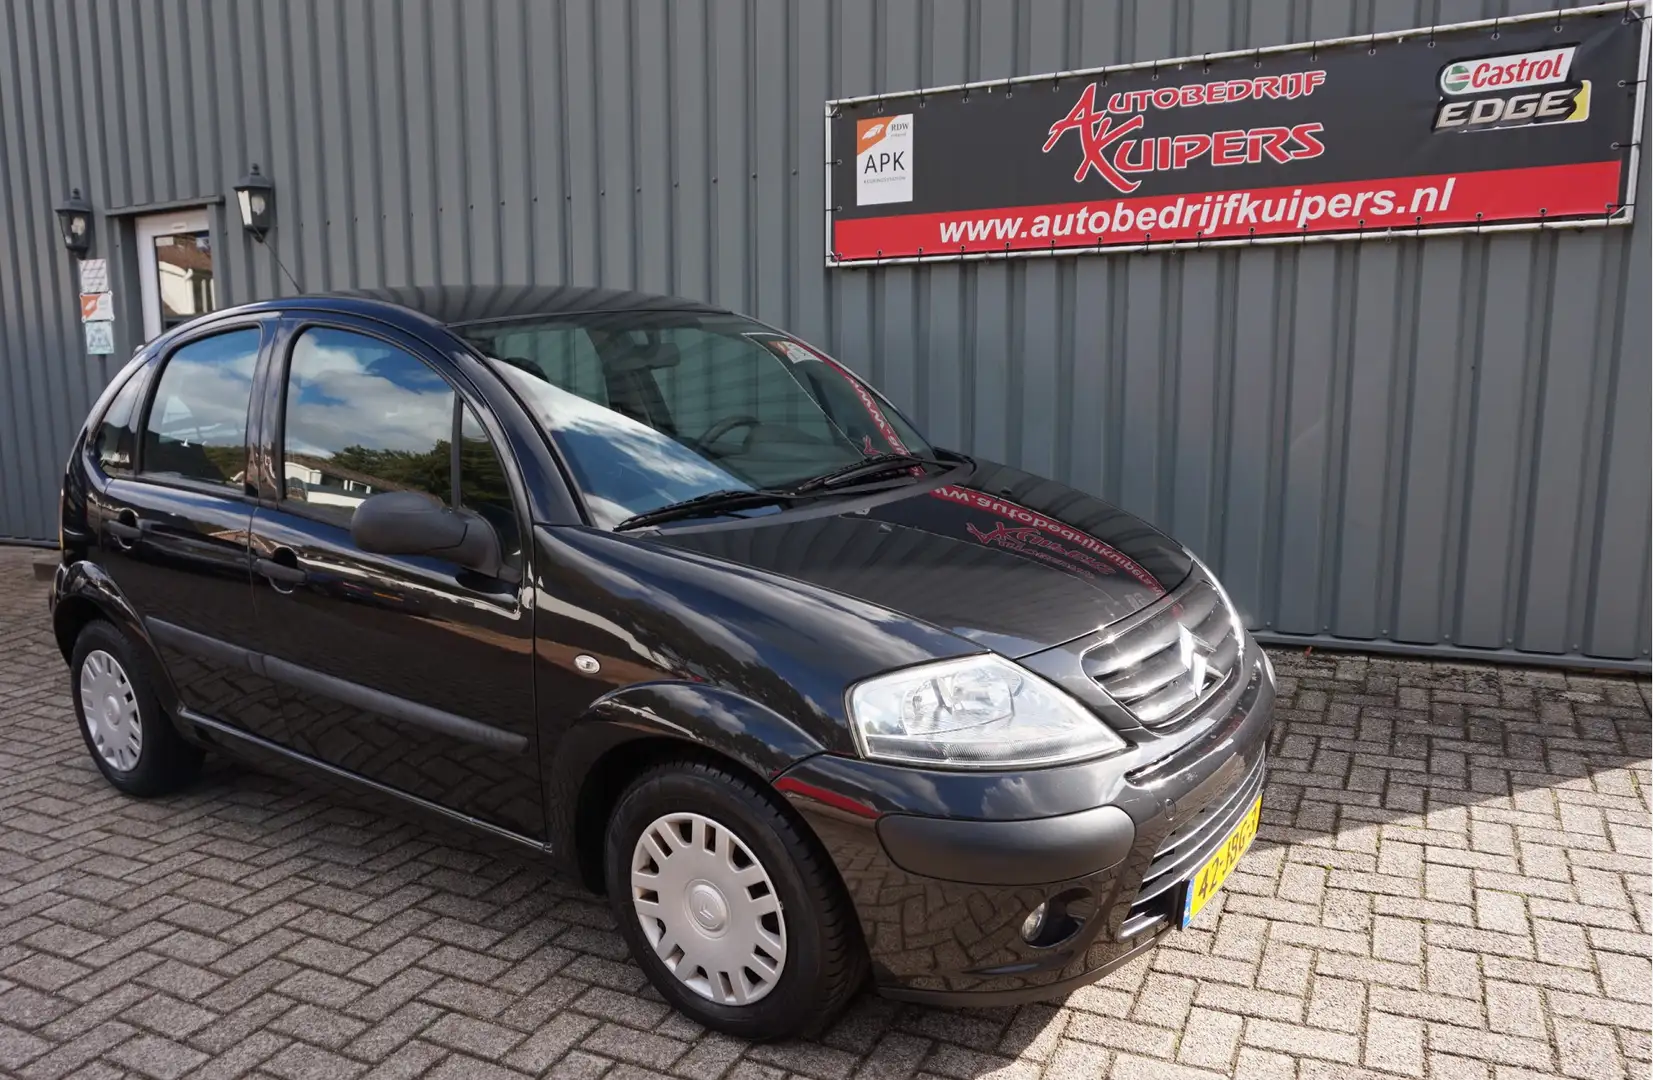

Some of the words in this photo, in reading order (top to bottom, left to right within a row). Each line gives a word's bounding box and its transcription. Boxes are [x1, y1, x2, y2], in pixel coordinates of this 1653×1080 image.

[1472, 53, 1564, 88] Castrol
[891, 122, 910, 132] RDW
[1042, 70, 1327, 153] AUTOBEDRIJF
[1436, 88, 1577, 129] EDGE
[864, 151, 905, 174] APK
[1074, 115, 1325, 193] KUIPERS
[939, 178, 1457, 244] www.autobedrijfkuipers.nl
